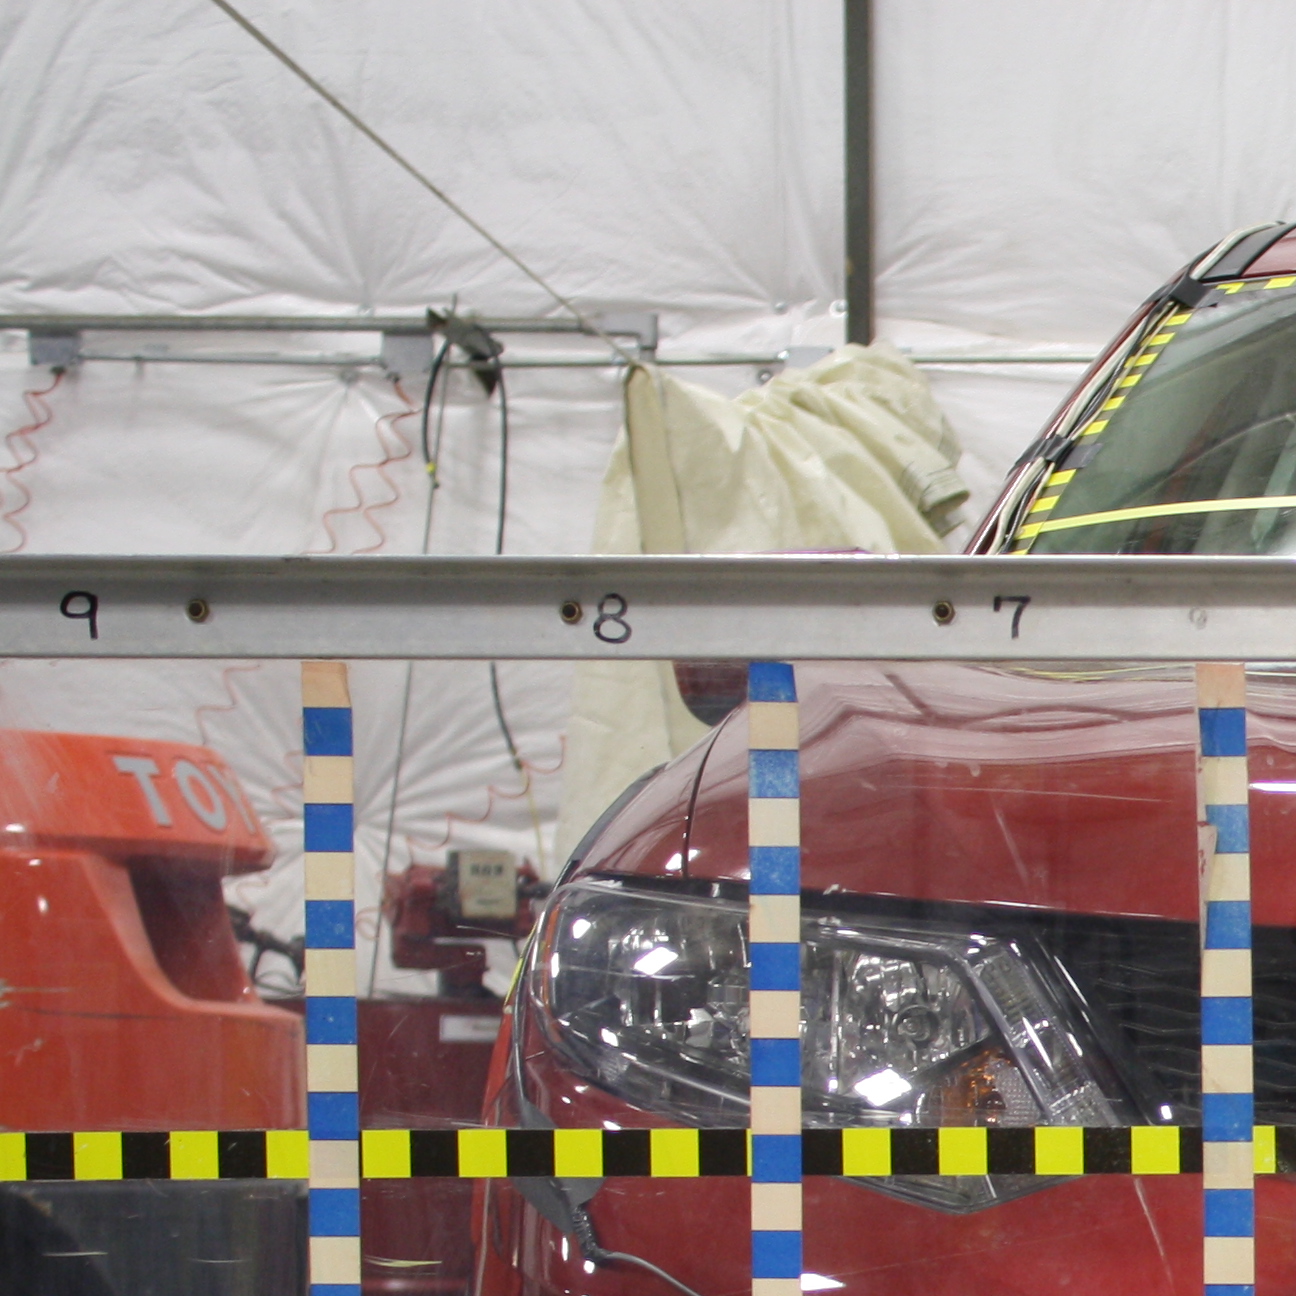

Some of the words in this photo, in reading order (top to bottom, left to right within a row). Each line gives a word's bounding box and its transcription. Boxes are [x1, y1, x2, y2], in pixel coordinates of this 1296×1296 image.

[60, 590, 98, 640] 9
[593, 593, 632, 644] 8
[993, 594, 1032, 640] 7
